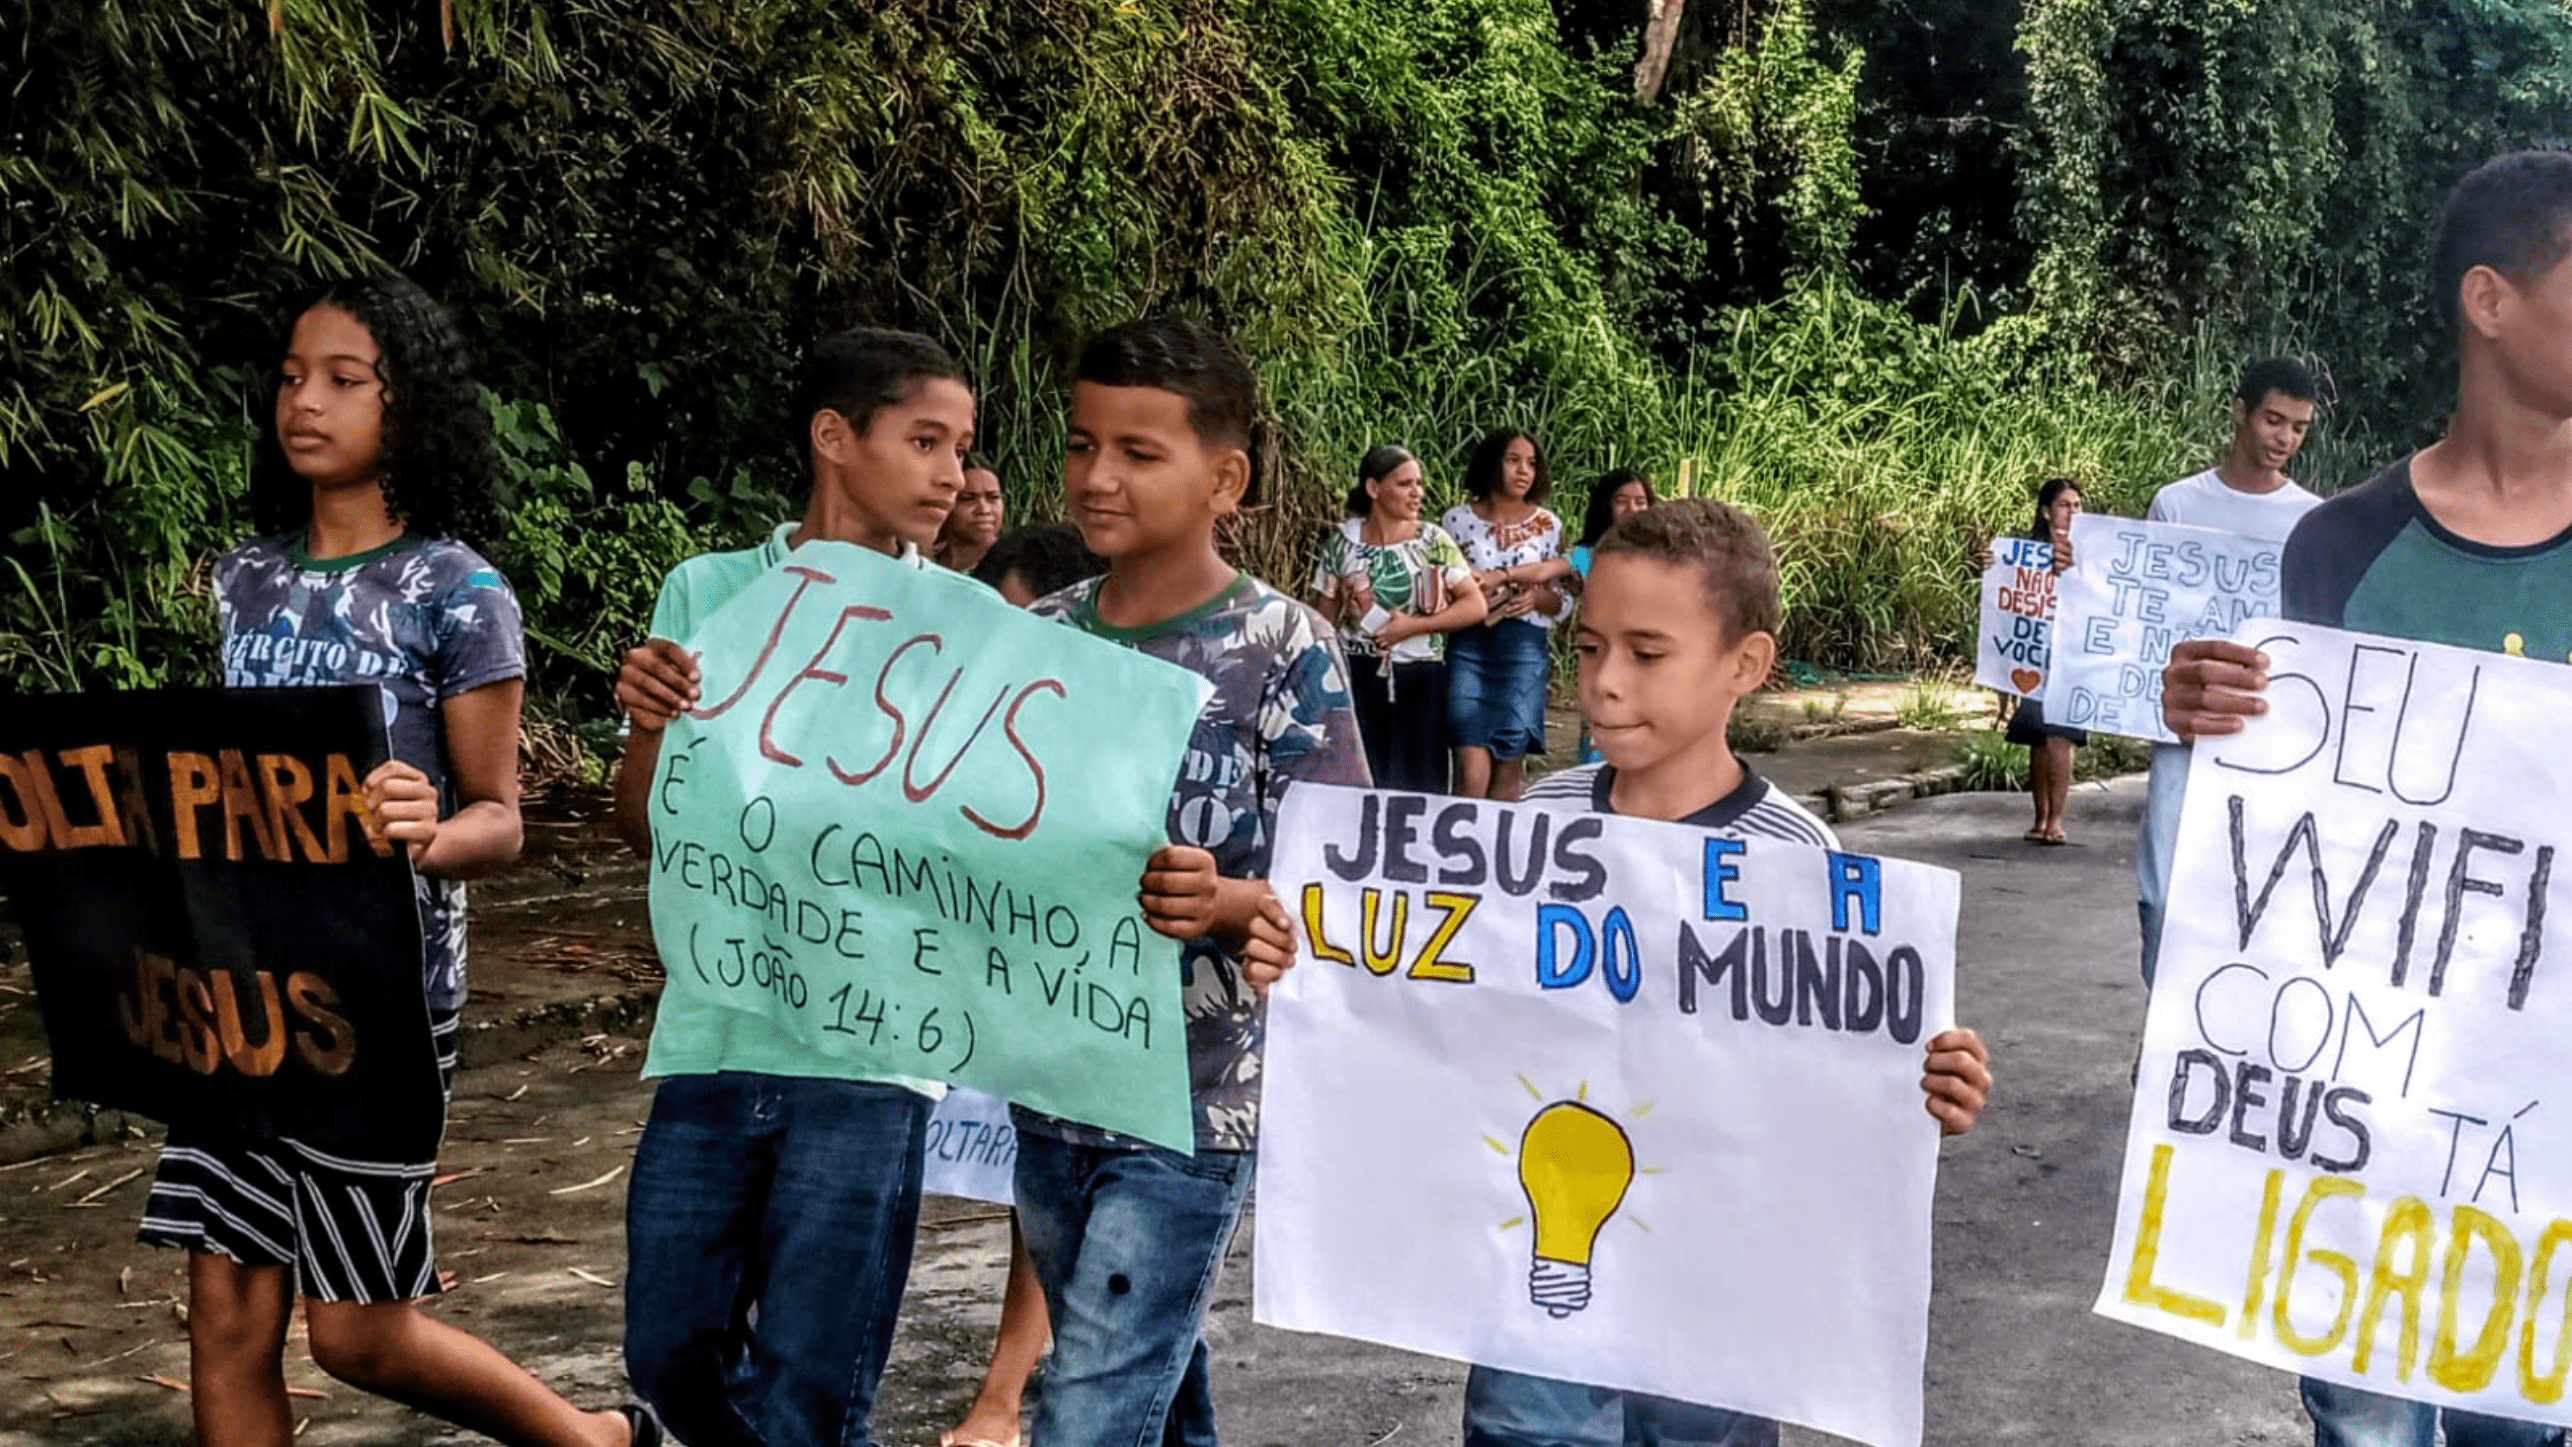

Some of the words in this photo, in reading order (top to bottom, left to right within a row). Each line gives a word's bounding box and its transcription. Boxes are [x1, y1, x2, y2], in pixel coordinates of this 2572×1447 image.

[2014, 616, 2048, 645] DE
[2107, 576, 2169, 624] TE
[2111, 531, 2280, 596] JESUS
[687, 566, 1067, 840] JESUS
[2084, 616, 2119, 655] E
[2067, 686, 2127, 733] DE
[2215, 636, 2480, 806] SEU
[167, 748, 395, 863] PARA
[660, 737, 706, 815] É
[740, 796, 775, 853] O
[1109, 917, 1141, 976] A
[1323, 795, 1608, 901] JESUS
[1826, 850, 1881, 935] A
[653, 840, 865, 959] VERDADE
[915, 929, 942, 974] E
[986, 947, 1011, 994] A
[690, 922, 808, 1009] (JOÃO
[1300, 883, 1483, 983] LUZ
[1537, 901, 1641, 1004] DO
[1677, 920, 1925, 1044] MUNDO
[2228, 795, 2554, 1011] WIFI
[118, 945, 357, 1076] JESUS
[2196, 963, 2425, 1098] COM
[2168, 1049, 2372, 1172] DEUS
[2428, 1100, 2540, 1214] TÁ
[2123, 1144, 2572, 1403] LIGADO
